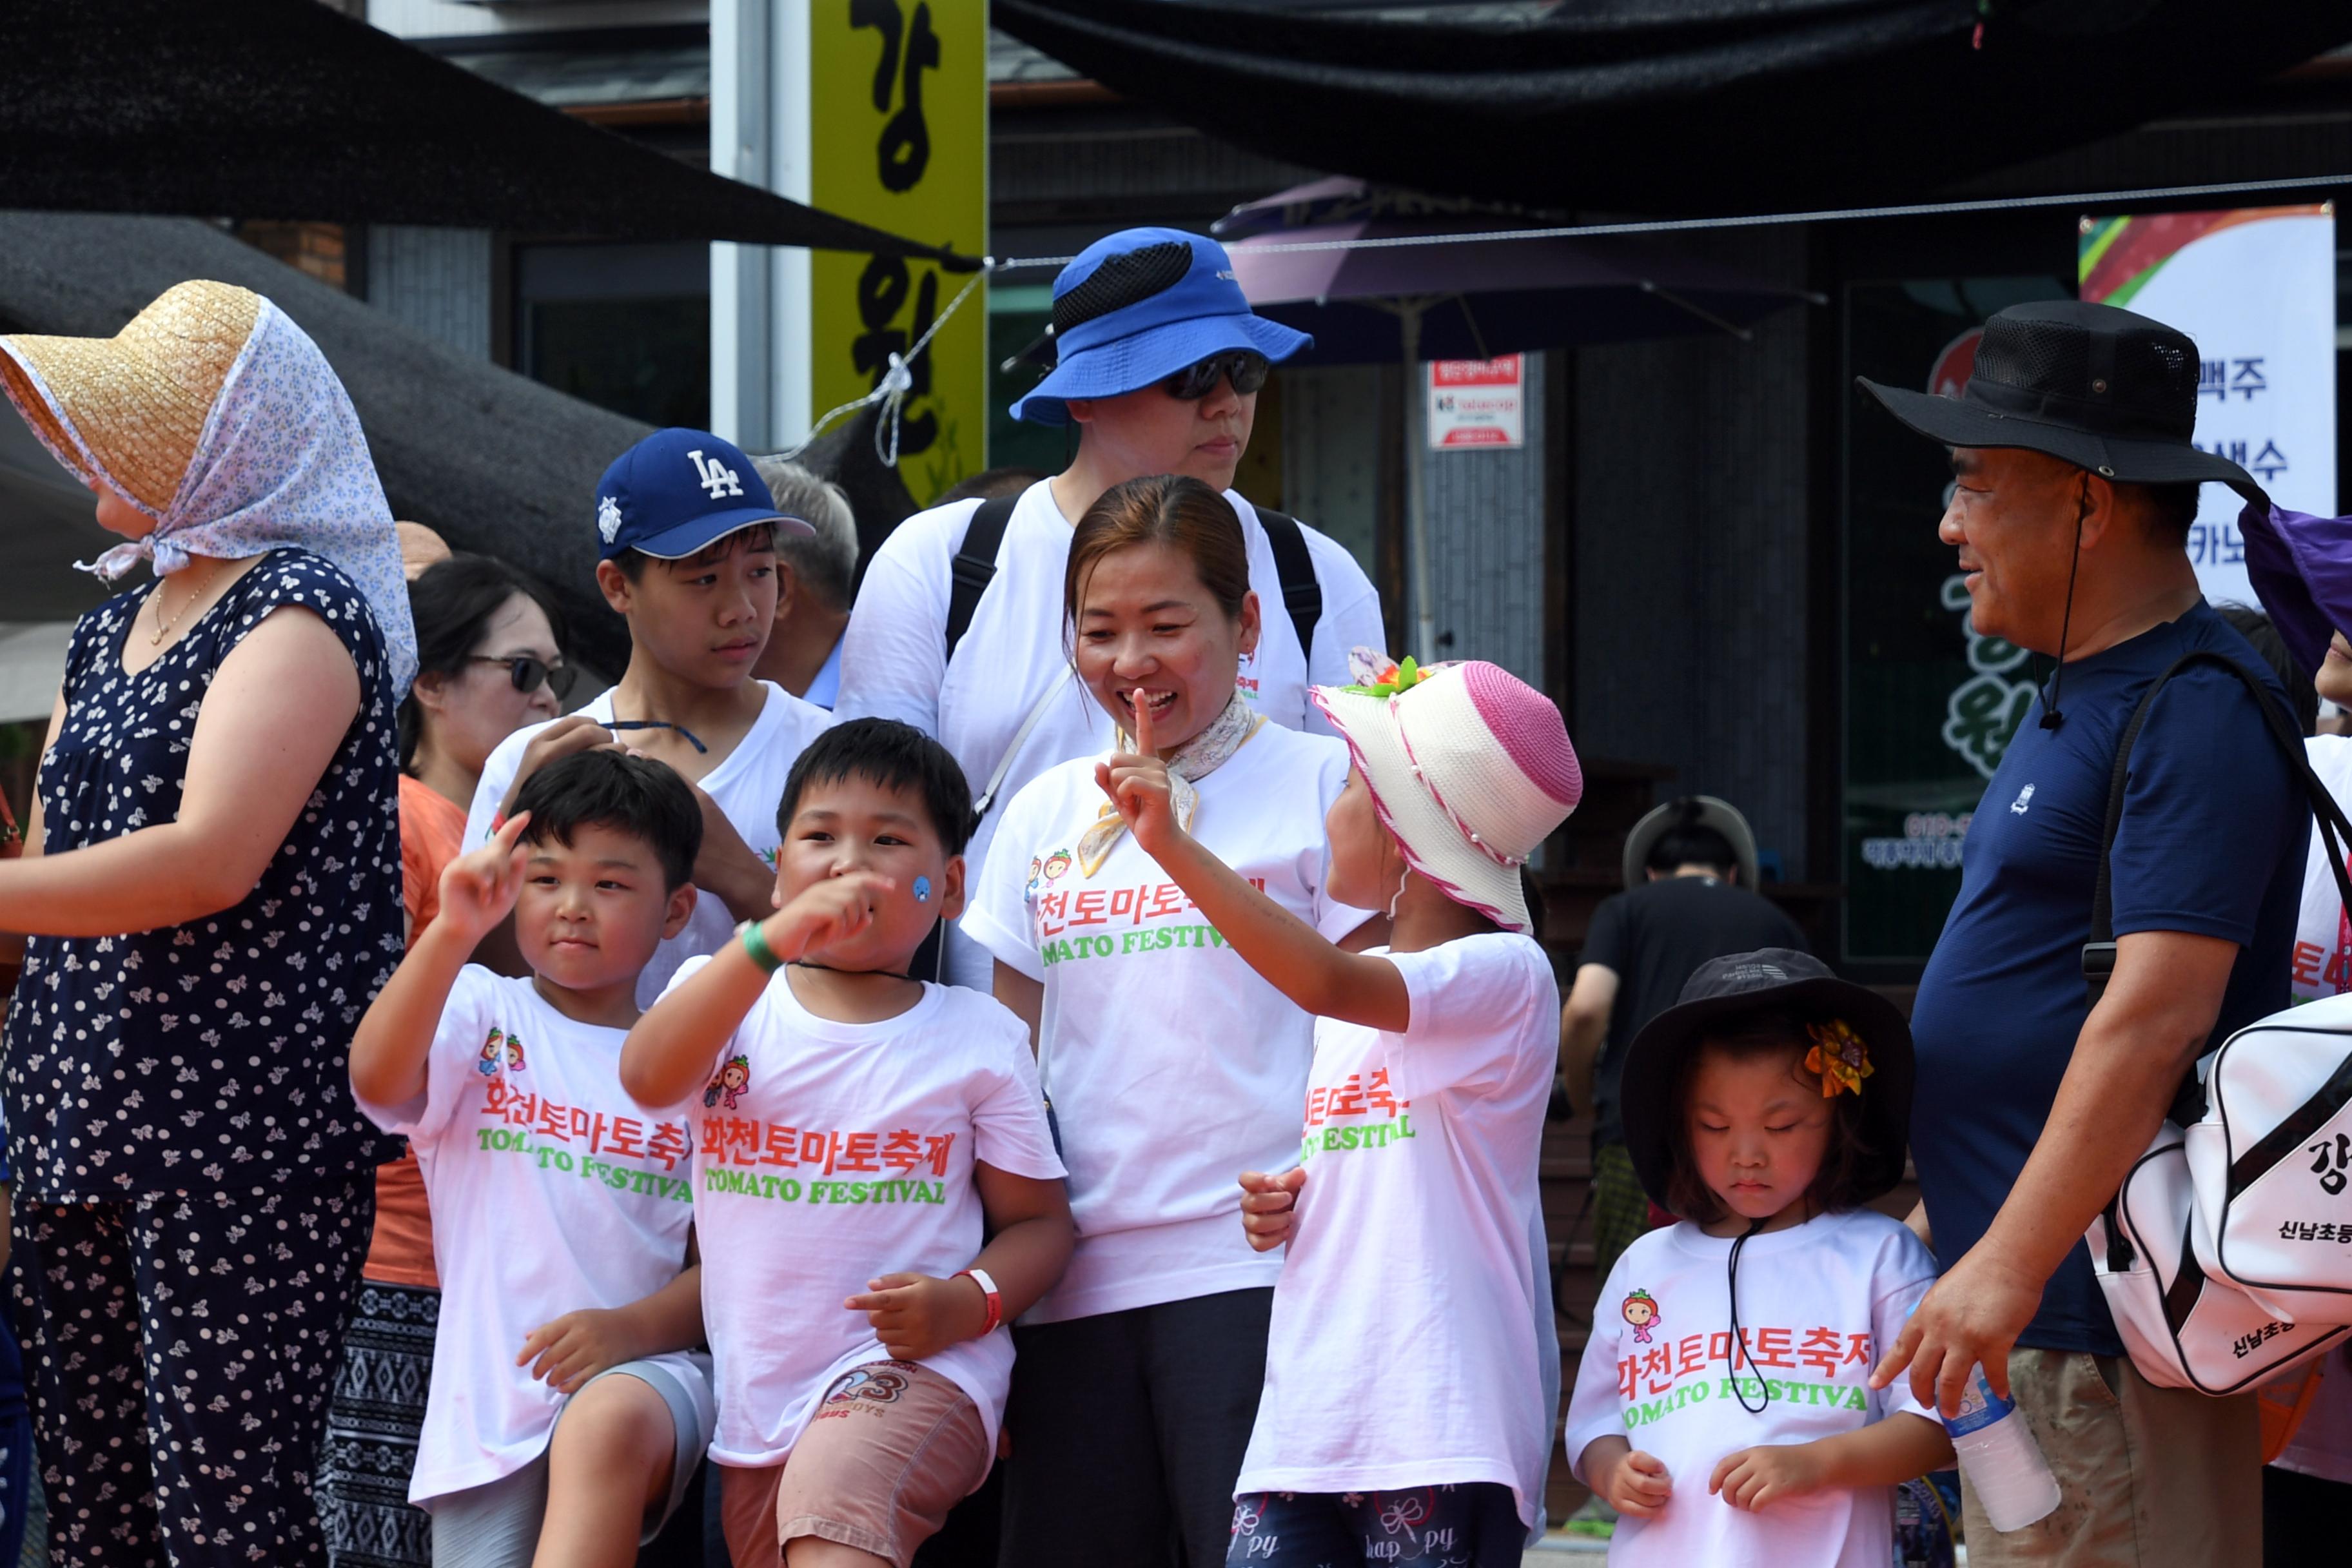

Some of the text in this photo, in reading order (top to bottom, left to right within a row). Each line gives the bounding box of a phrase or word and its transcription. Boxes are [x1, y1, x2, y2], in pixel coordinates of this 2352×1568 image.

[687, 450, 744, 500] LA
[1121, 925, 1235, 954] FESTIV
[480, 1077, 693, 1171] 화천토마토축
[700, 1116, 956, 1177] 화천토마토축제
[705, 1168, 946, 1205] TOMATO FESTIVAL
[1622, 1378, 1710, 1430] OMATO
